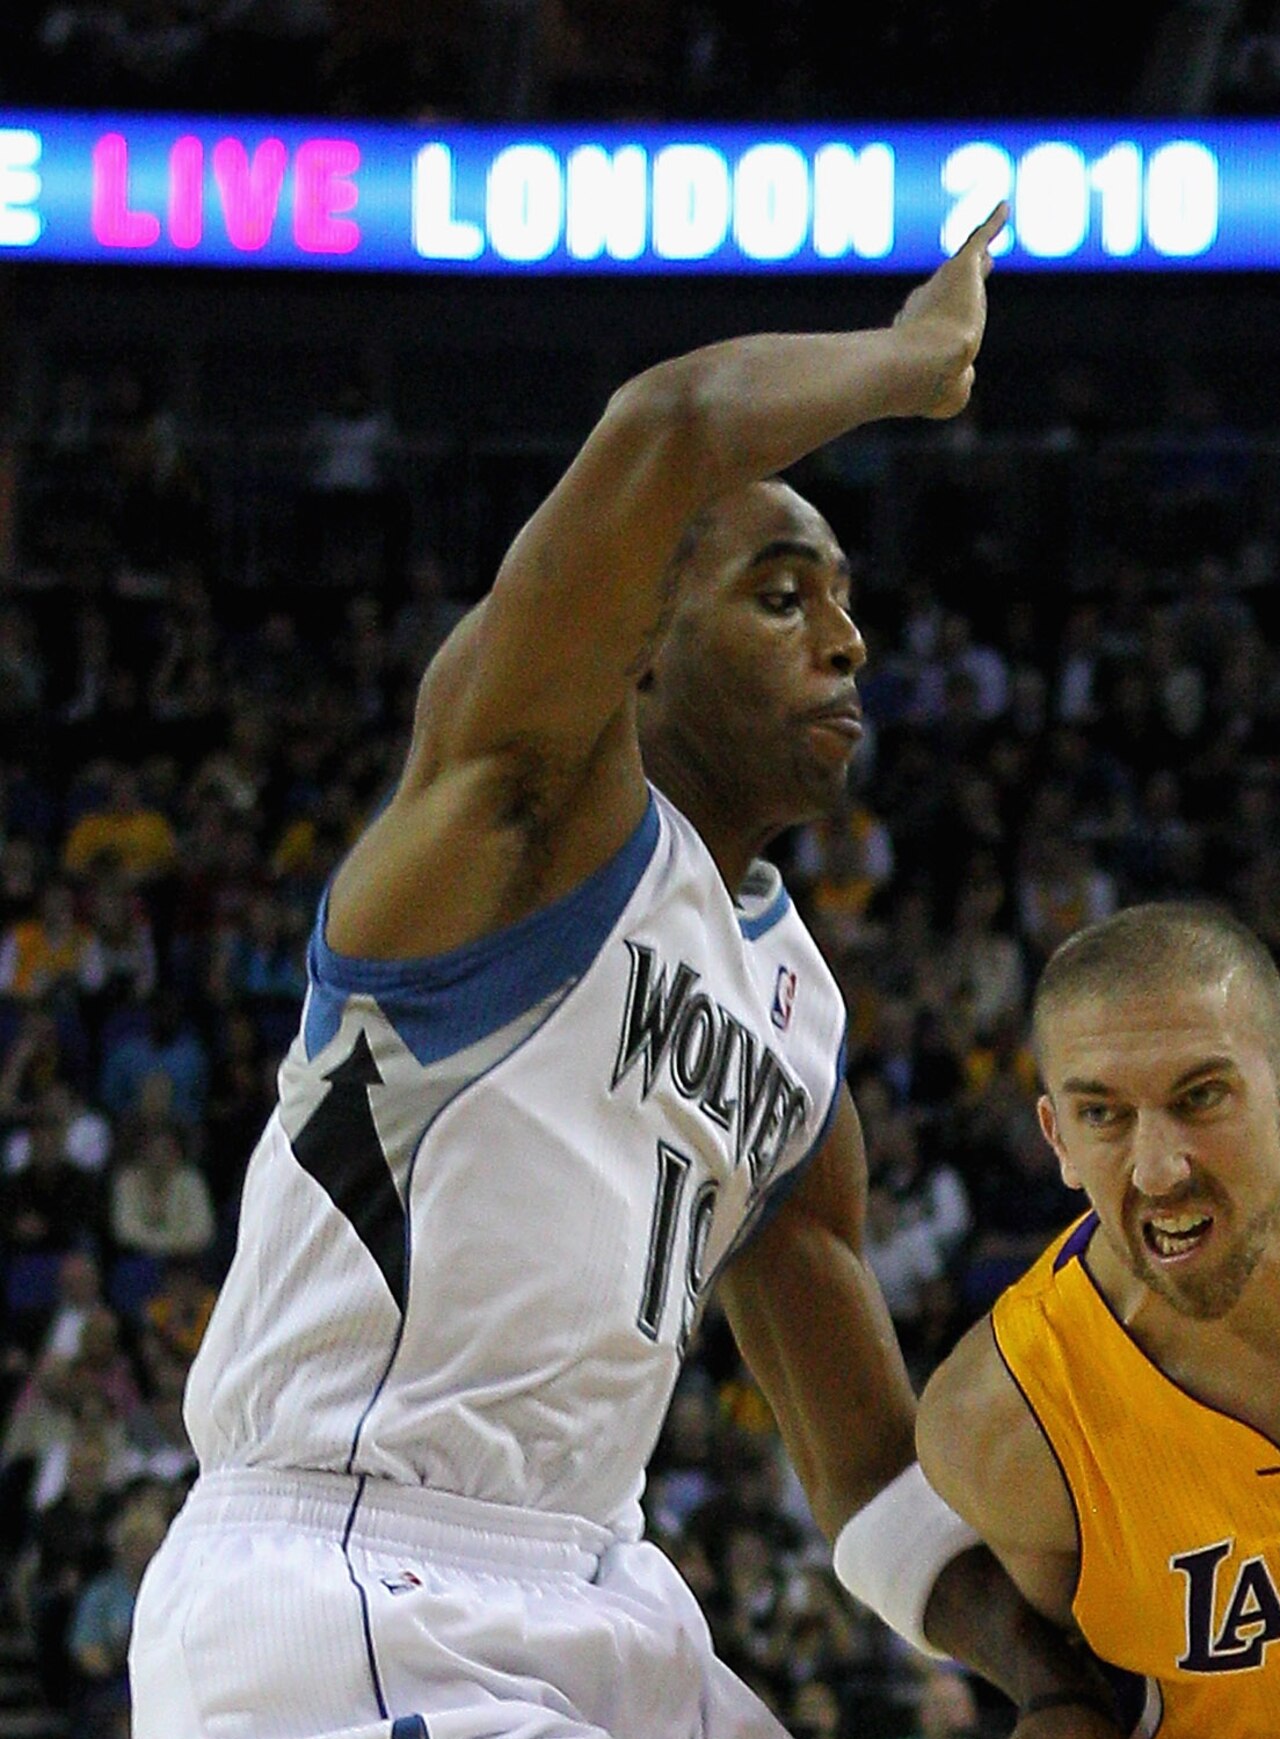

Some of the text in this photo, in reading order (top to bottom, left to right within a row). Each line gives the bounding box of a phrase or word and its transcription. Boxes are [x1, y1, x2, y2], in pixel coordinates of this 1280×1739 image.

[93, 132, 360, 254] LIVE
[413, 141, 895, 261] LONDON
[941, 140, 1218, 258] 2010
